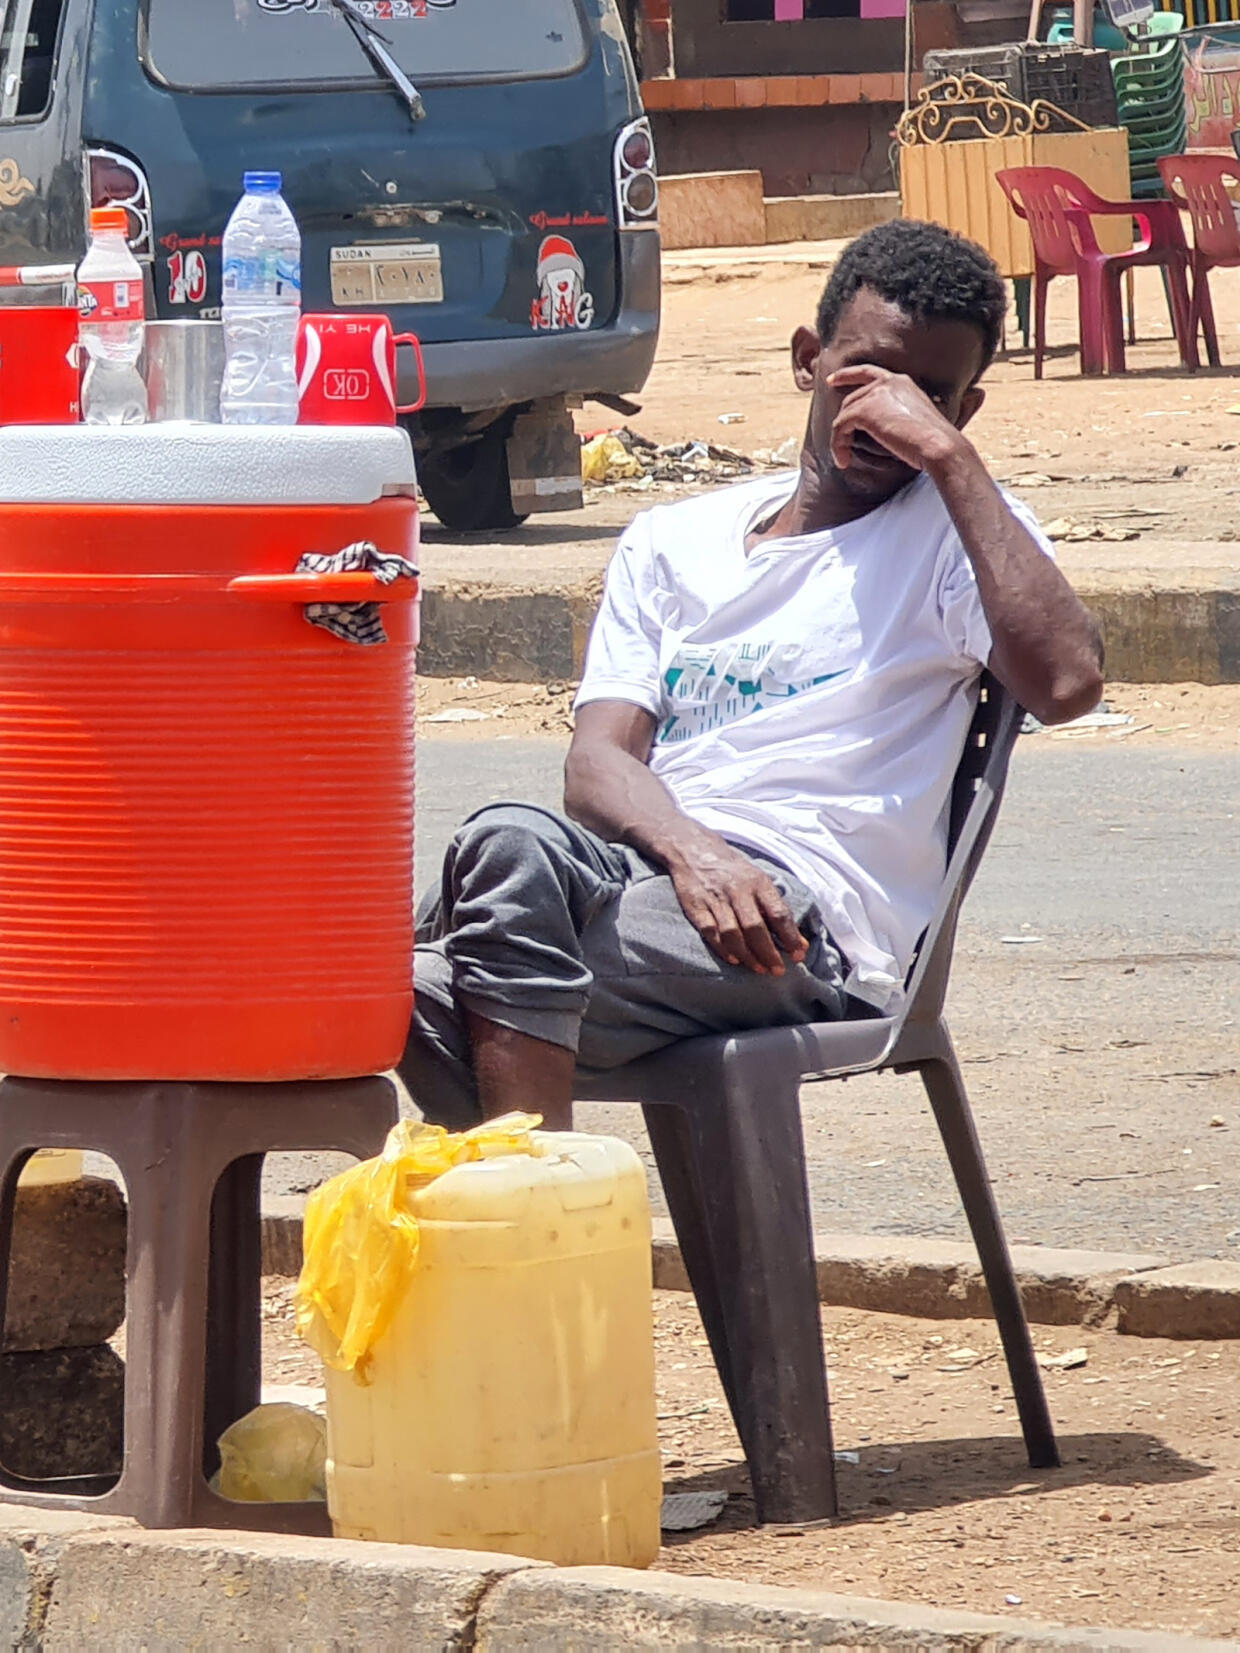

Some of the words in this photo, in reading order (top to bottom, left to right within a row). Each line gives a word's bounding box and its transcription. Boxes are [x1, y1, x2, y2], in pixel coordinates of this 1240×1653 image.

[335, 249, 371, 259] SUDAN
[167, 250, 207, 304] 10
[529, 292, 595, 330] KING
